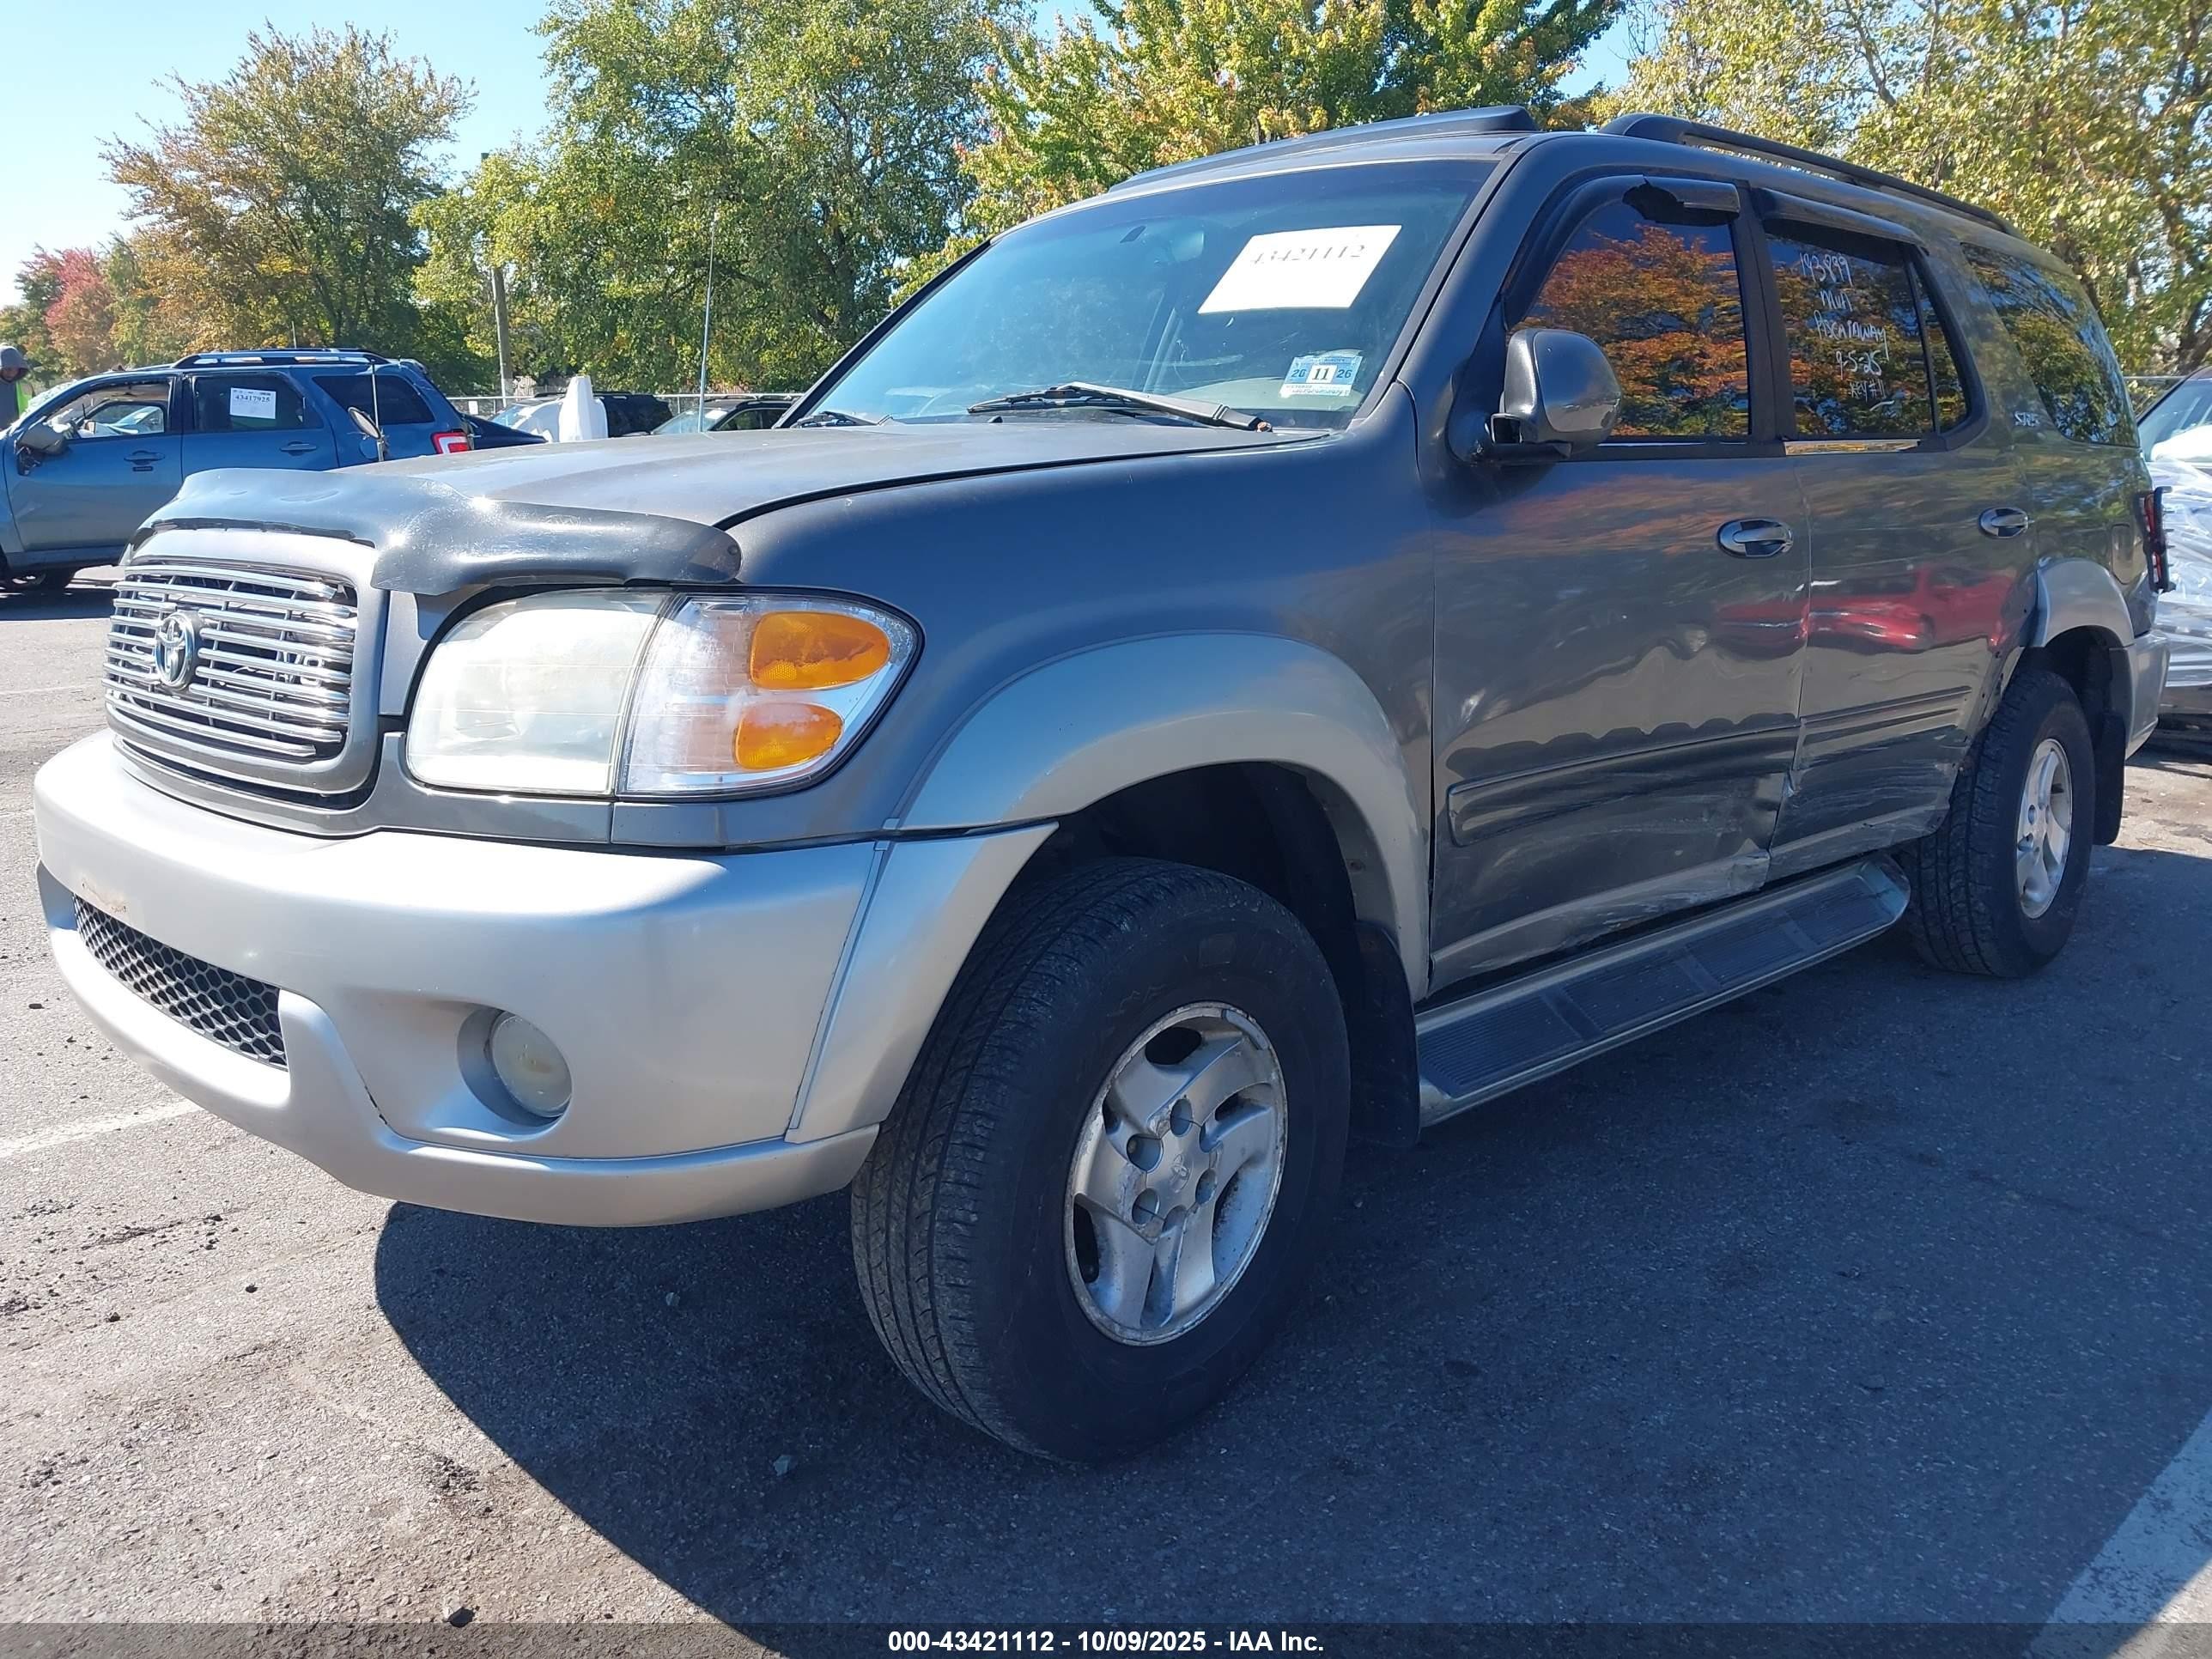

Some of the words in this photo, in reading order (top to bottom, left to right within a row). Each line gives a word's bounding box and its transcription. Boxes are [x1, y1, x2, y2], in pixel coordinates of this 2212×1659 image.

[1291, 368, 1307, 379] 20
[1312, 368, 1330, 380] 11
[1336, 369, 1353, 379] 26
